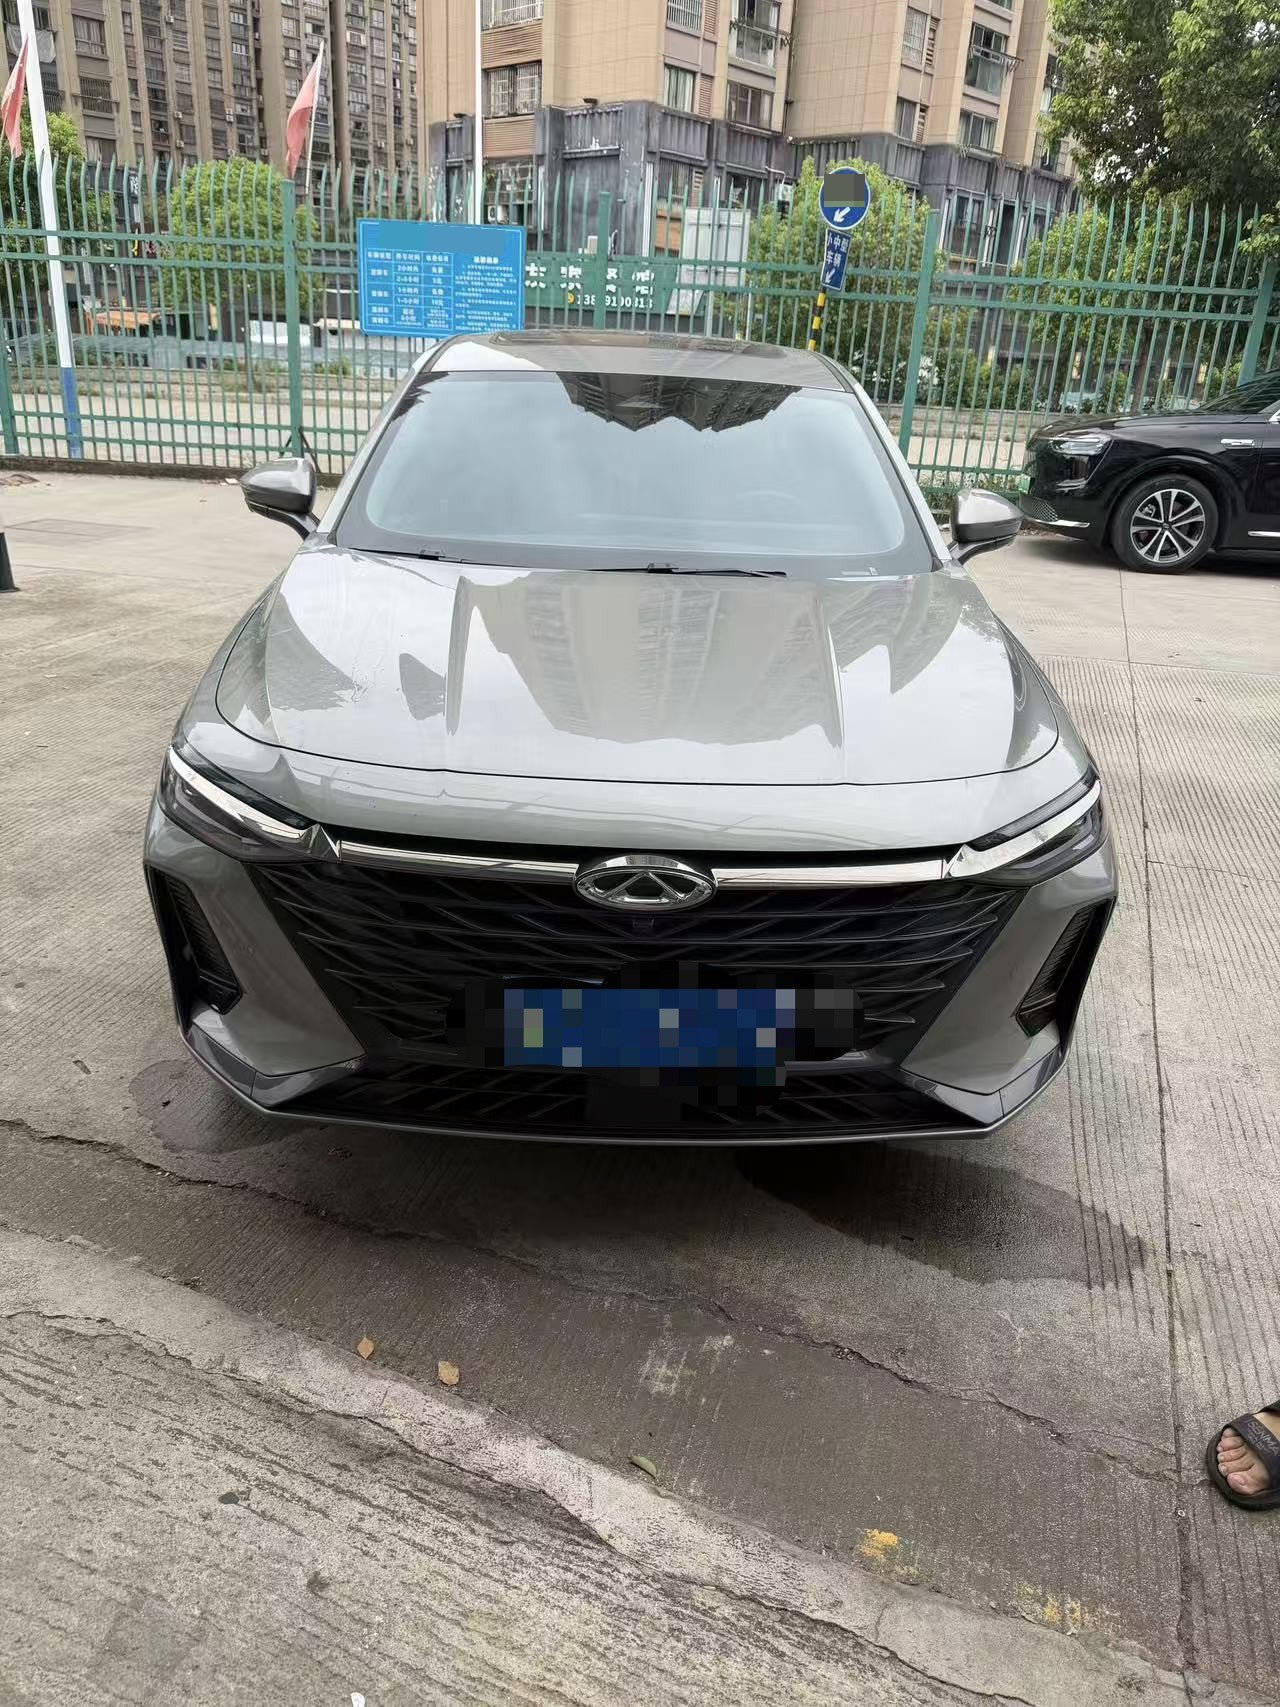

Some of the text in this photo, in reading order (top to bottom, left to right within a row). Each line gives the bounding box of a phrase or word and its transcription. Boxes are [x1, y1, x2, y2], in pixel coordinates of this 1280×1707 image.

[828, 232, 849, 253] 小中型
[826, 250, 842, 268] 车辆
